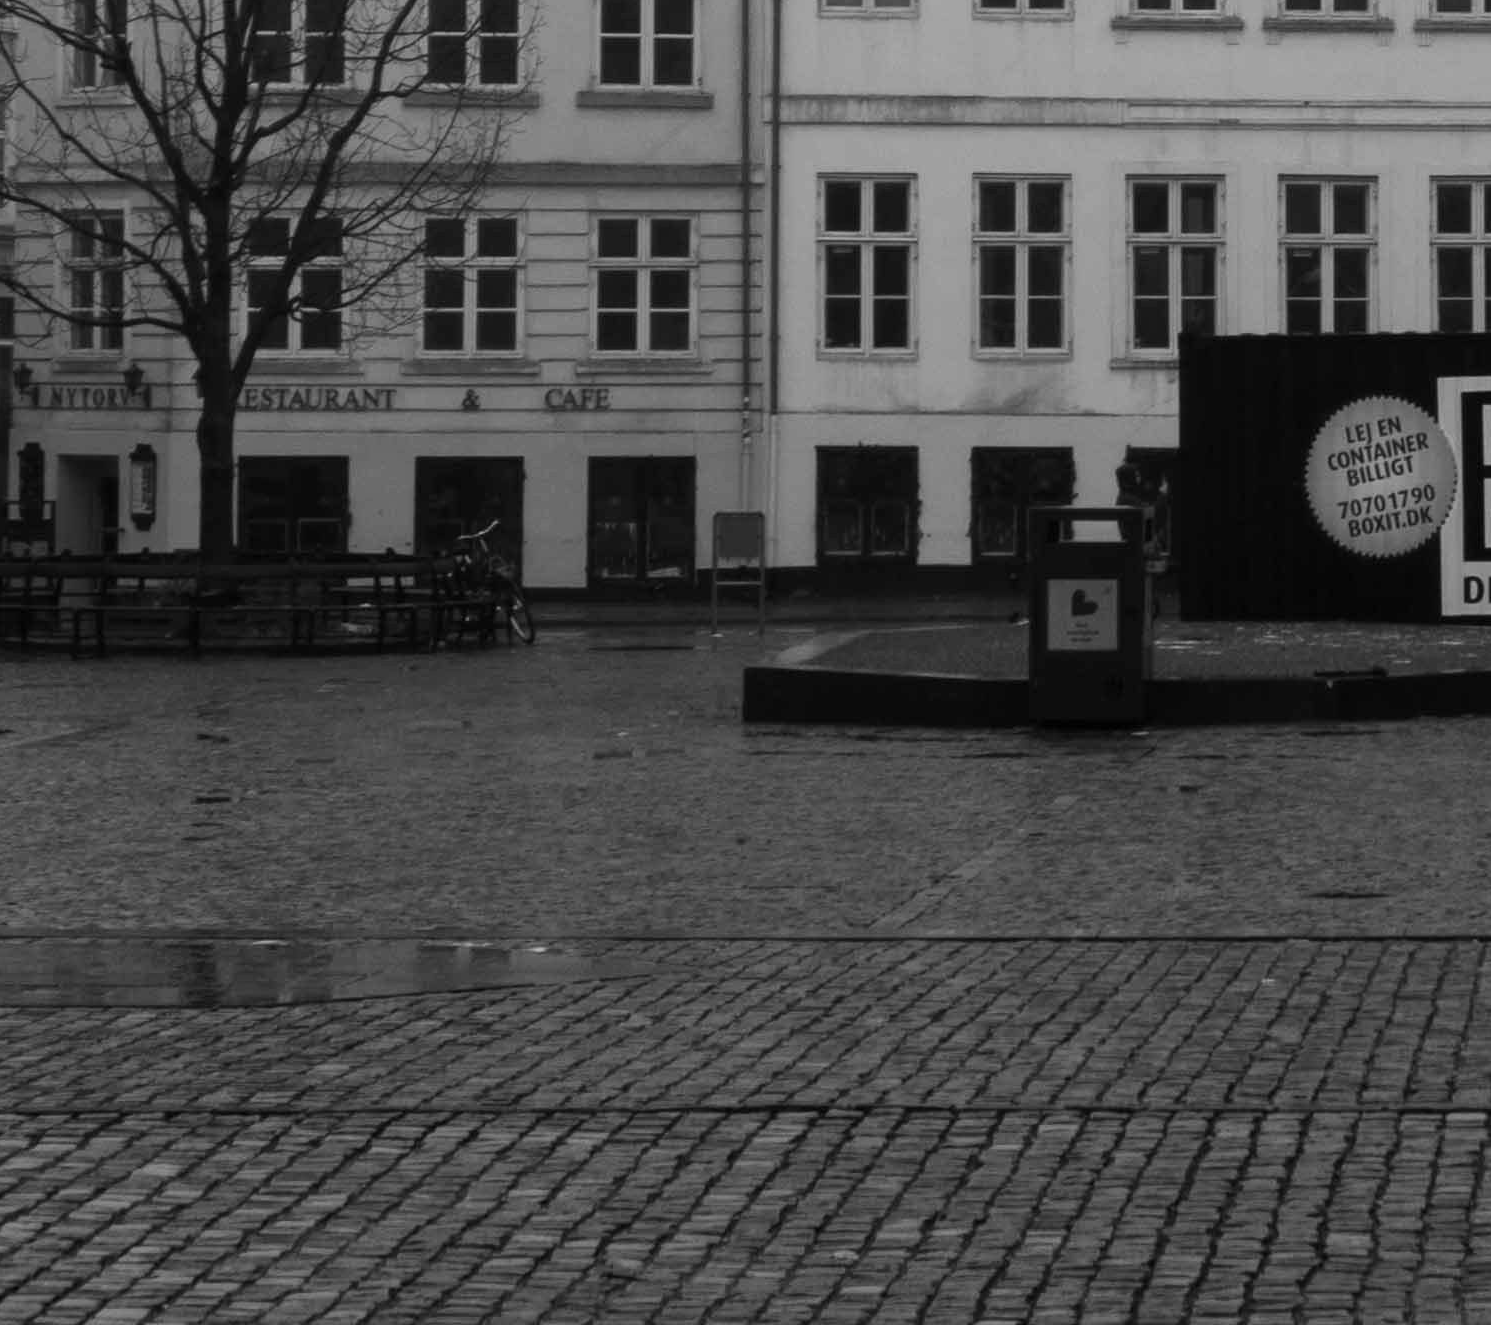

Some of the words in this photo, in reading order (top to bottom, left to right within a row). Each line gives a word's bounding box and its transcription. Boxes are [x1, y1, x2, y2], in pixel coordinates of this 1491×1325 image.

[237, 387, 396, 411] ESTAURANT
[462, 388, 482, 411] &
[544, 388, 612, 411] CAFE
[1344, 422, 1373, 445] LEJ
[1377, 415, 1402, 437] EN
[1327, 432, 1429, 471] CONTAINER
[1346, 455, 1414, 487] BILLIGT
[1348, 505, 1434, 537] BOXIT.DK
